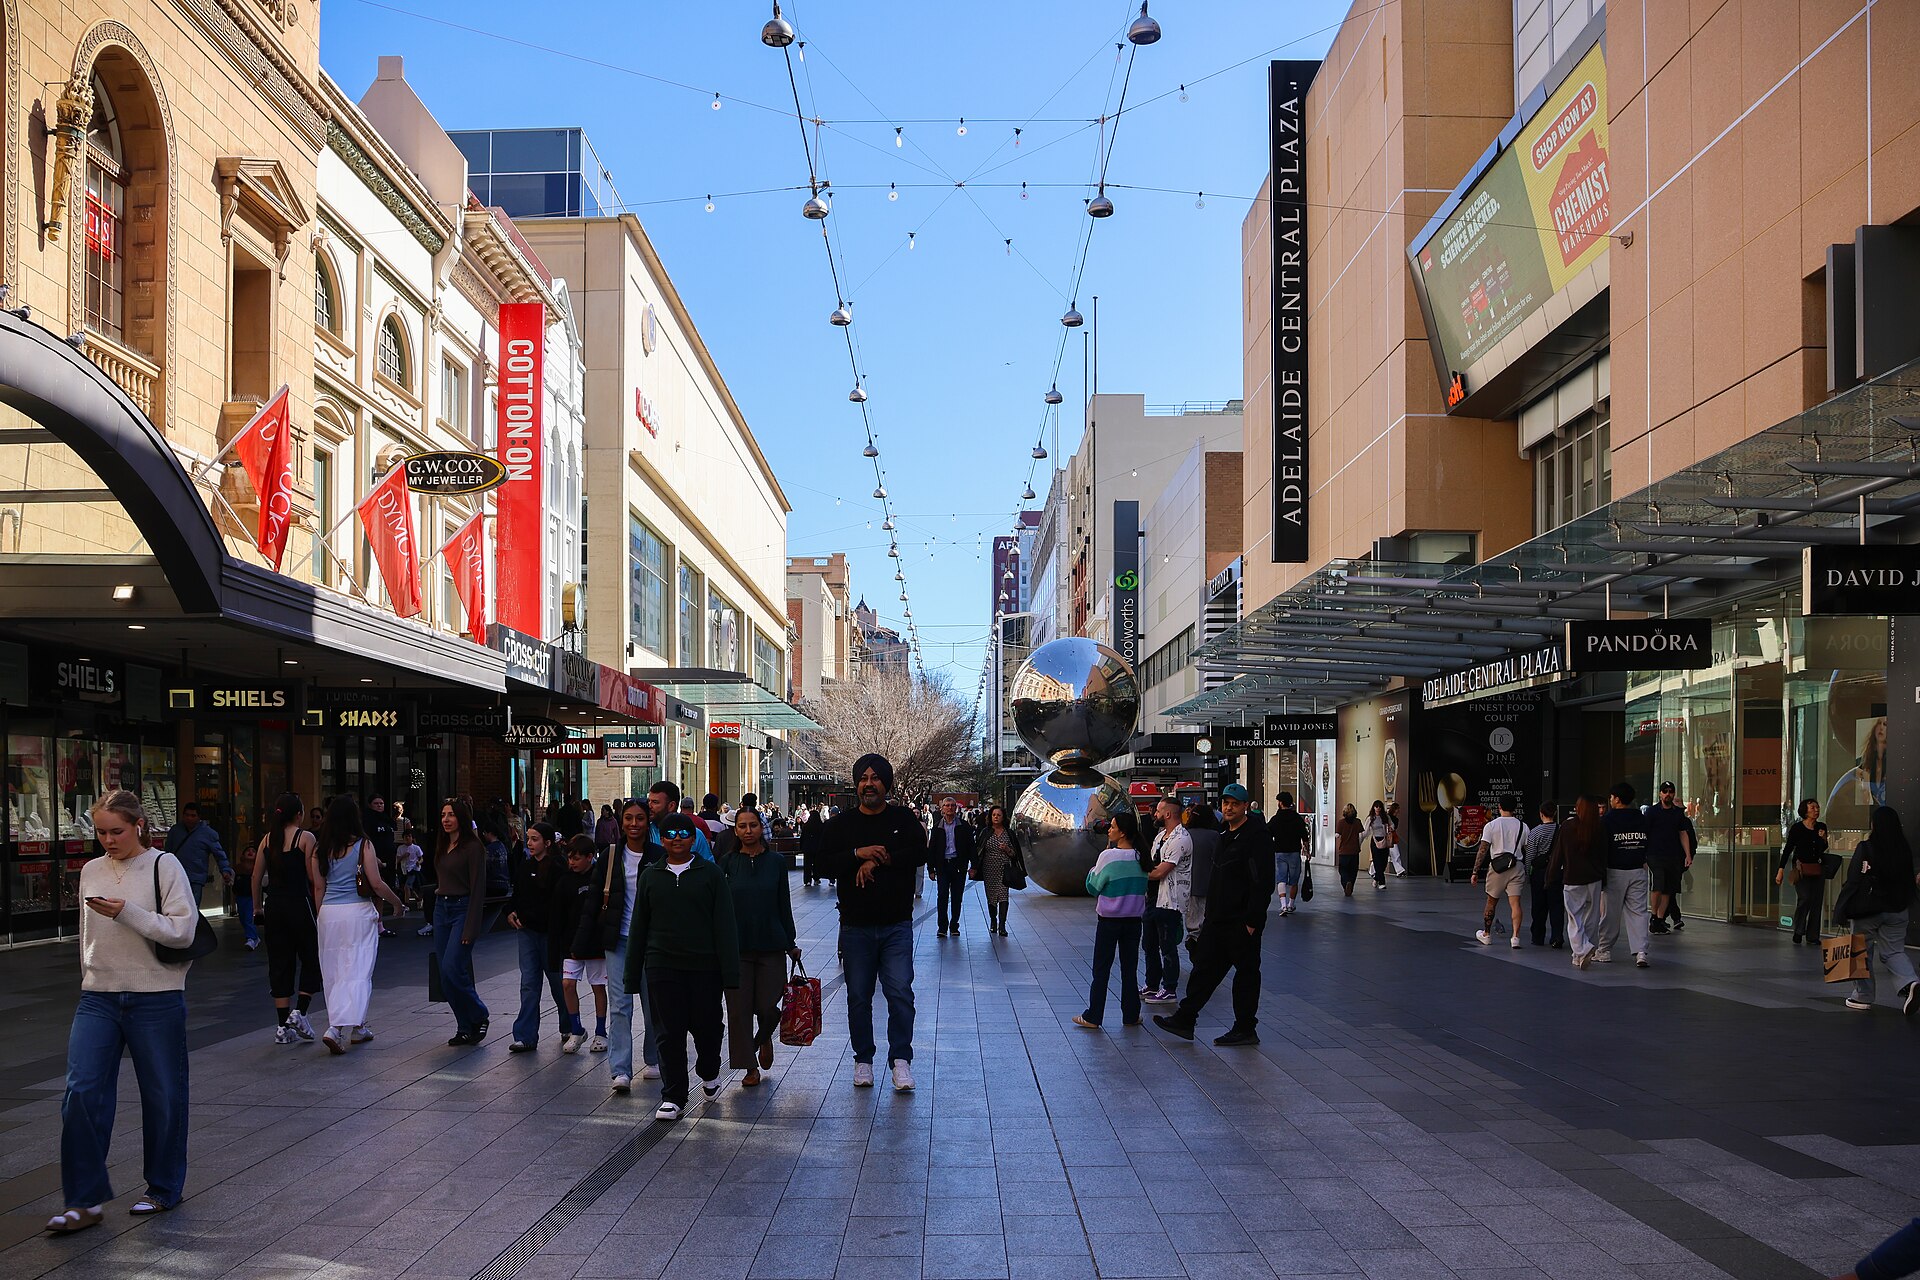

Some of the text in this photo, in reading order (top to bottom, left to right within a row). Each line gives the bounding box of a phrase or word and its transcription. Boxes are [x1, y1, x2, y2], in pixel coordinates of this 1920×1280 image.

[1535, 91, 1593, 165] SHOP NOW AT
[1554, 160, 1610, 236] CHEMIST
[1440, 197, 1501, 269] SCIENCE BACKED.
[1562, 203, 1609, 254] WAREHOUS
[1280, 208, 1301, 353] CENTRAL
[1281, 370, 1302, 526] ADELAIDE
[409, 475, 483, 485] MY JEWELLER
[1826, 569, 1904, 587] DAVID
[1587, 630, 1698, 653] PANDORA
[504, 638, 551, 676] CROSS CUT
[58, 662, 114, 694] SHIELS
[1422, 646, 1560, 702] ADELAIDE CENTRAL PLAZA
[213, 690, 286, 707] SHIELS
[1469, 703, 1535, 712] FINEST FOOD
[339, 709, 398, 727] SHADES
[420, 714, 503, 726] CROSS CUT
[1270, 723, 1334, 731] DAVID JONES
[1484, 714, 1519, 722] COURT
[526, 724, 558, 737] COX
[710, 724, 739, 734] coles
[1229, 739, 1243, 747] THE
[1832, 944, 1850, 962] NIKE
